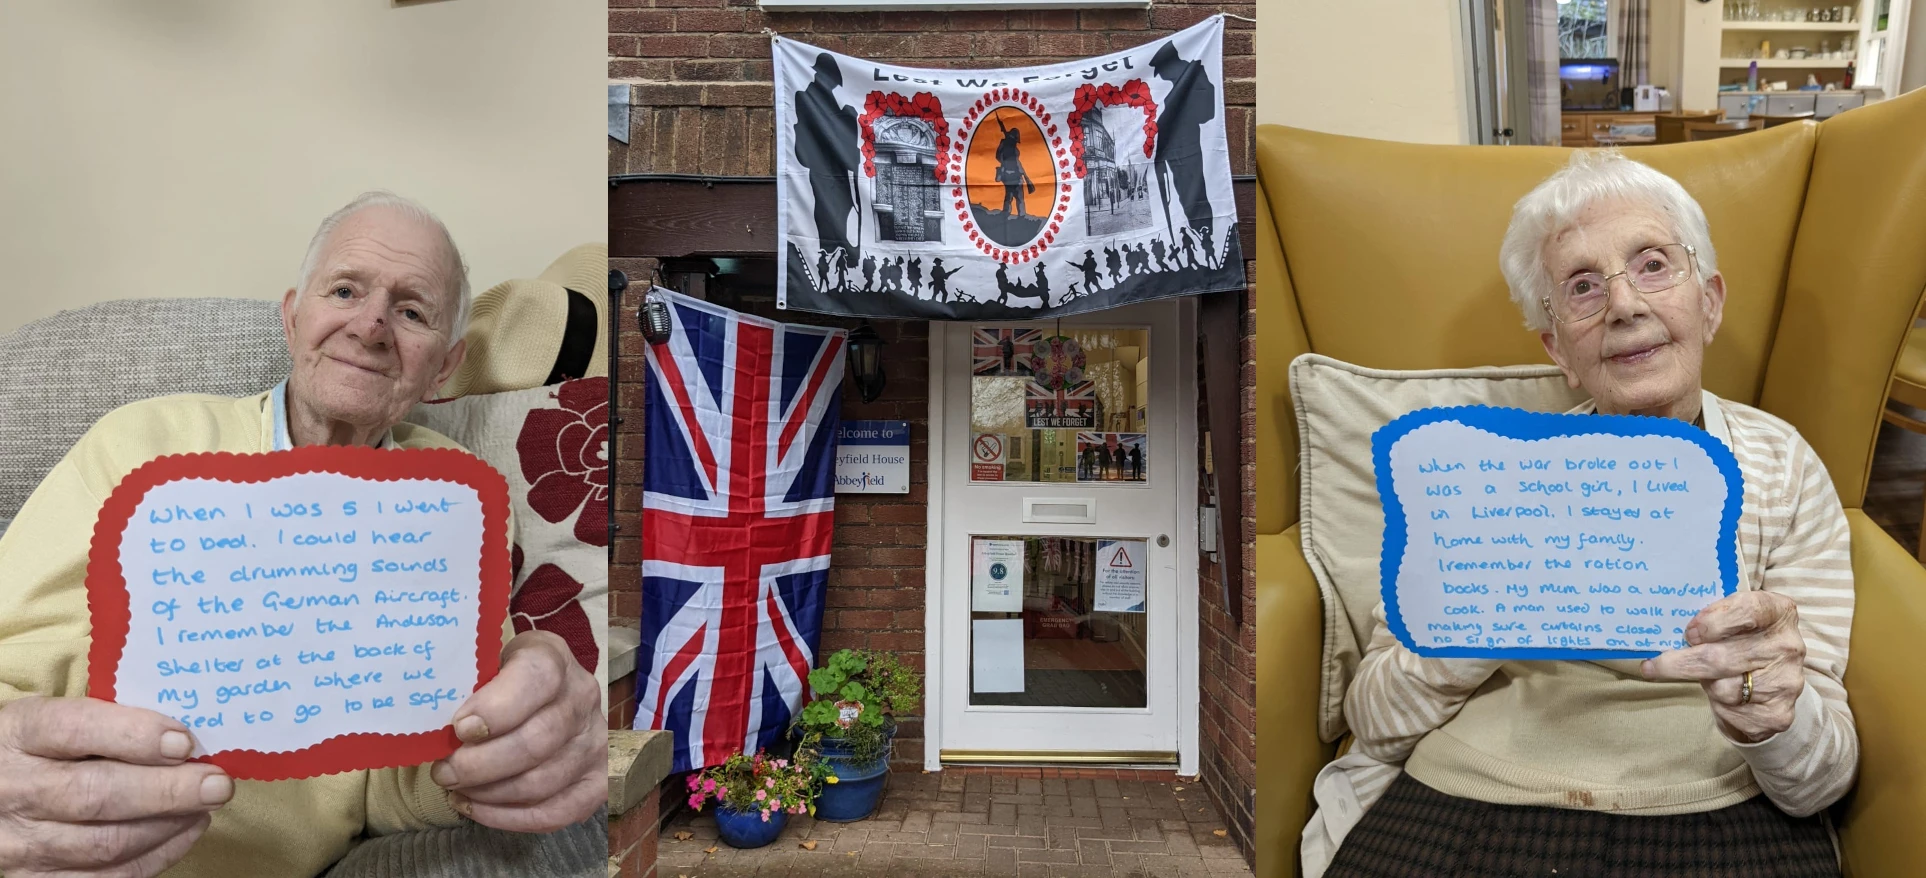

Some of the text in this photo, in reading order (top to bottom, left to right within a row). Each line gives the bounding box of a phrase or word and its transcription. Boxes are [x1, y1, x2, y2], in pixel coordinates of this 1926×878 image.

[873, 56, 1134, 88] Lest We Forget
[1033, 418, 1087, 427] LEST WE FORGET
[837, 427, 894, 439] elcome to
[835, 454, 905, 467] eyfield House
[1478, 459, 1505, 472] the
[1518, 460, 1552, 471] war
[1564, 457, 1616, 471] broke
[1628, 460, 1665, 470] out
[1484, 484, 1496, 495] a
[270, 502, 323, 518] was
[342, 500, 358, 517] 5
[395, 497, 463, 514] went
[1430, 509, 1450, 520] in
[1581, 506, 1641, 521] stayed
[1649, 507, 1674, 520] at
[149, 538, 186, 554] to
[199, 534, 255, 552] bed.
[292, 530, 357, 546] could
[371, 531, 431, 544] hear
[1433, 532, 1644, 552] home with my family.
[152, 558, 448, 586] the drumming sounds
[993, 567, 1004, 575] 9.8
[1544, 559, 1572, 570] the
[1584, 559, 1648, 571] ration
[1442, 582, 1499, 595] books.
[1588, 584, 1622, 594] was
[1627, 585, 1641, 595] a
[152, 588, 468, 622] of the German Aircraft.
[1443, 605, 1485, 616] cook.
[1495, 602, 1506, 613] A
[1512, 604, 1544, 613] man
[1556, 603, 1590, 614] used
[1600, 605, 1616, 615] to
[1626, 607, 1663, 617] walk
[177, 623, 294, 643] remember
[315, 619, 352, 634] the
[1492, 622, 1526, 632] sure
[1541, 622, 1602, 633] curtains
[1615, 624, 1662, 635] closed
[1433, 635, 1453, 644] no
[1517, 634, 1533, 645] of
[1546, 636, 1591, 648] lights
[1605, 638, 1627, 650] on
[1635, 638, 1656, 647] at
[1659, 638, 1688, 649] nigh
[255, 654, 281, 670] at
[297, 650, 335, 664] the
[353, 643, 406, 659] back
[412, 640, 434, 661] of
[215, 680, 291, 704] garden
[314, 672, 383, 690] where
[402, 667, 435, 681] we
[171, 688, 465, 730] sed to go to be safe.
